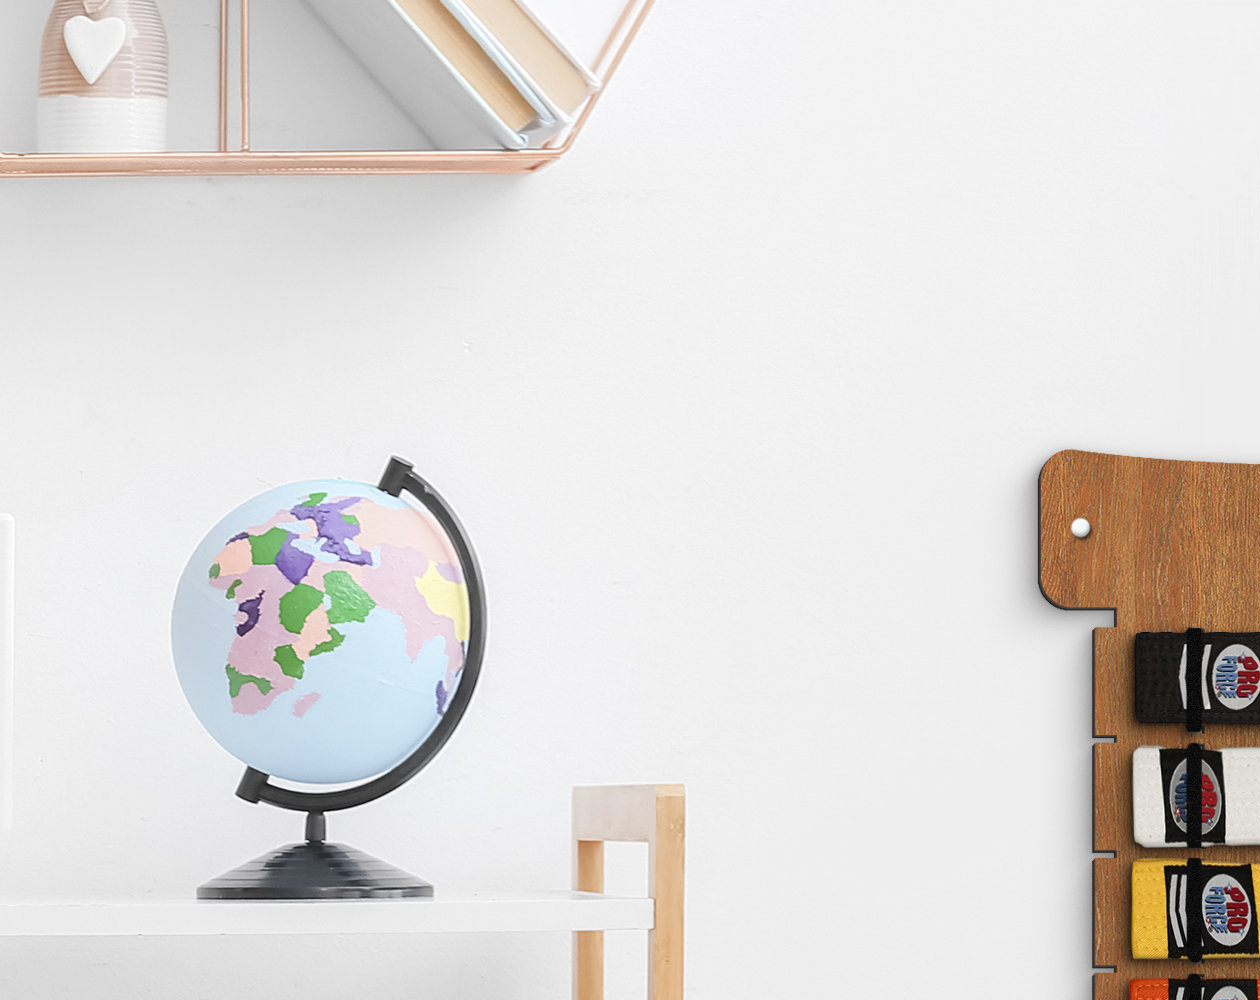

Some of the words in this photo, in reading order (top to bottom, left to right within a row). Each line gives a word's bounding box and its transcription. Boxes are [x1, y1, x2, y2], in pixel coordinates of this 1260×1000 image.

[1216, 656, 1238, 698] FORCE
[1237, 655, 1260, 698] PRO
[1205, 886, 1228, 933] FORCE
[1224, 886, 1249, 933] PRO
